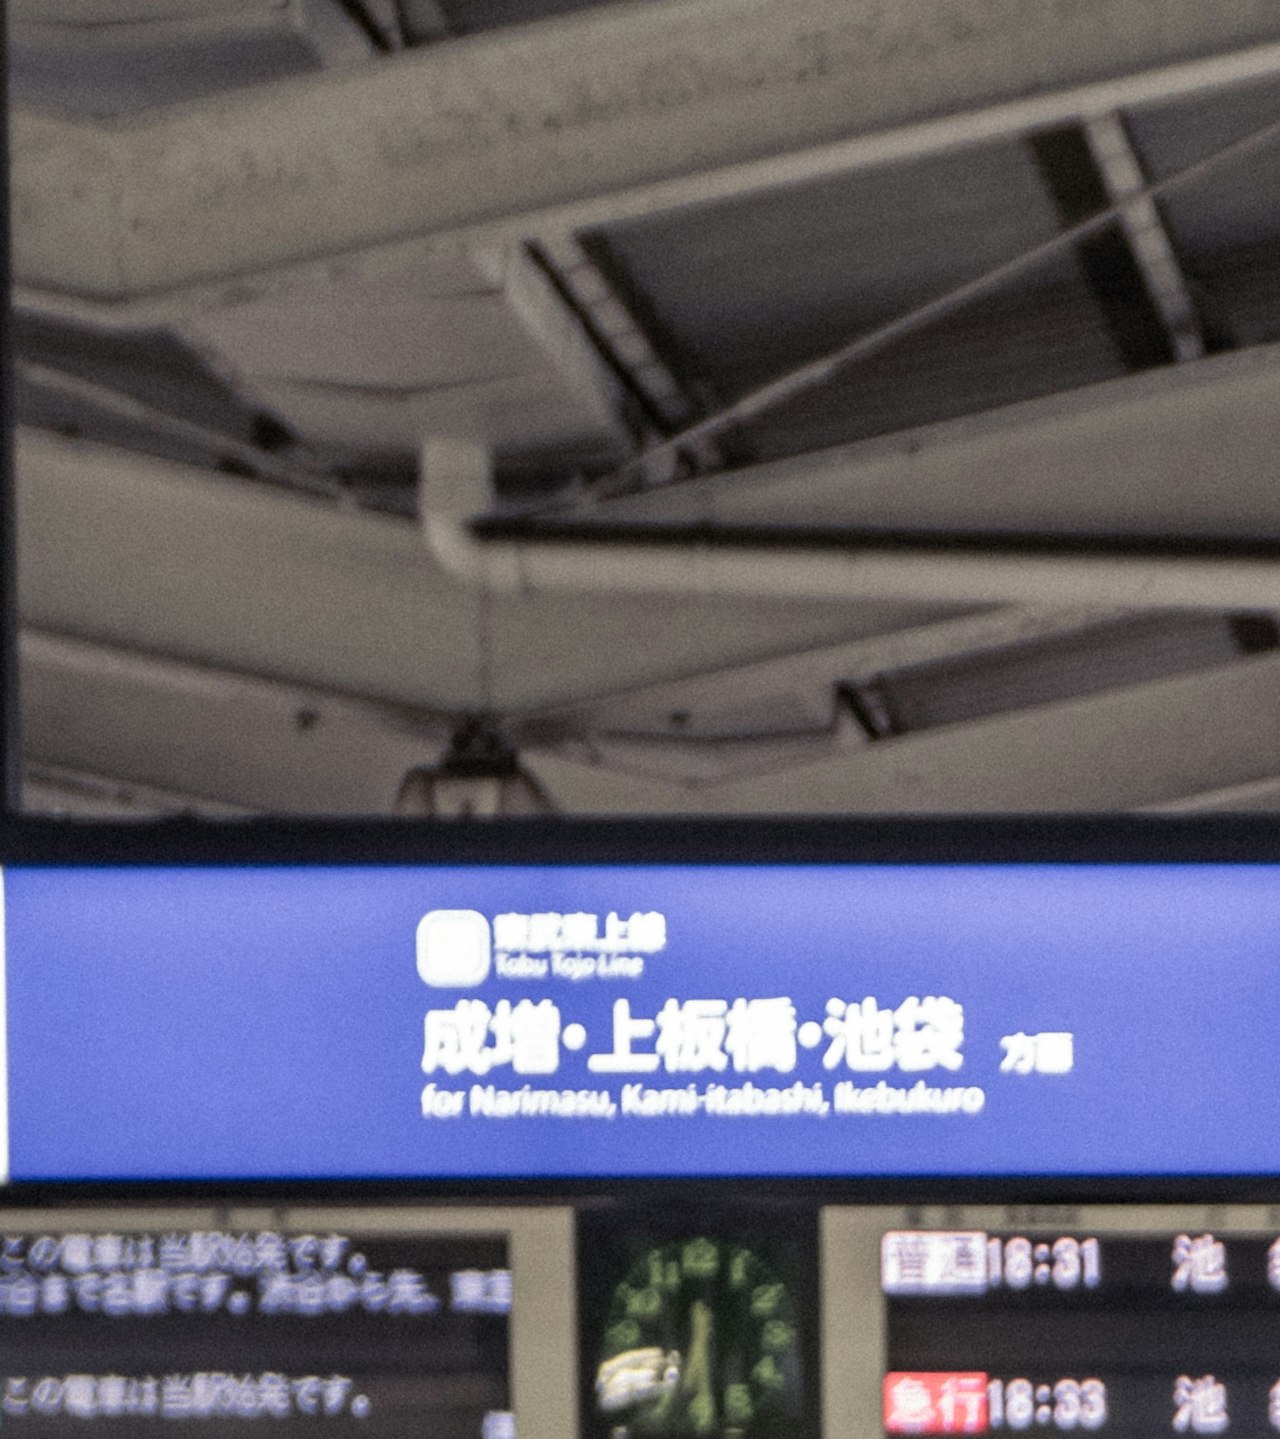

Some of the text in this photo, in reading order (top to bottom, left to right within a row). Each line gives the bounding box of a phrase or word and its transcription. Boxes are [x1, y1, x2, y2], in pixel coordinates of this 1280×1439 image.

[421, 1082, 466, 1119] for
[469, 1083, 617, 1118] Narimasu,
[834, 1080, 985, 1114] Ikebukuro
[986, 1237, 1101, 1288] 18:31
[887, 1377, 986, 1432] 急行
[988, 1378, 1108, 1430] 18:33
